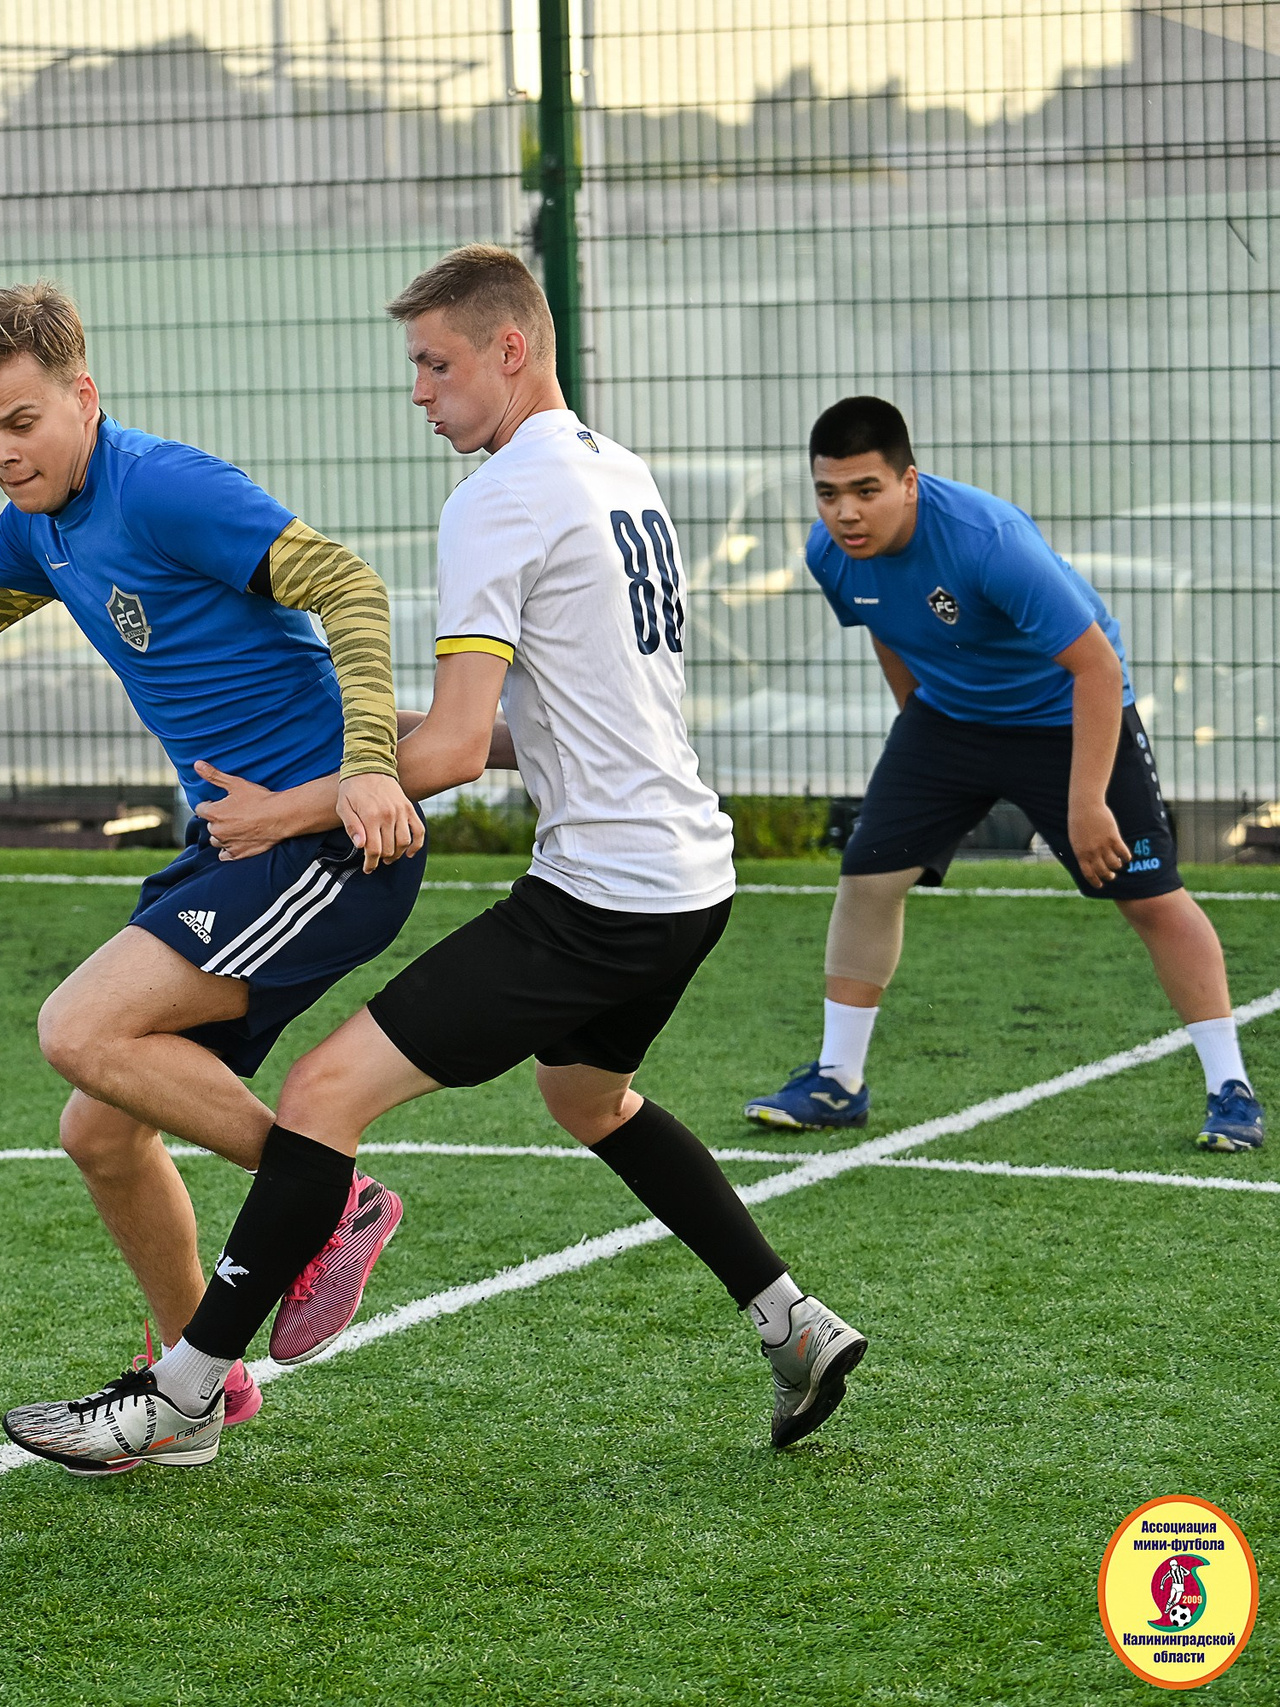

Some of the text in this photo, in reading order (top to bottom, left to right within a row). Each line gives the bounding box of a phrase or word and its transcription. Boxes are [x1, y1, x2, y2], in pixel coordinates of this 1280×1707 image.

[610, 509, 684, 655] 80
[935, 601, 954, 613] FC
[116, 609, 142, 632] FC
[1134, 838, 1151, 856] 46
[1127, 857, 1161, 873] JAKO
[177, 911, 212, 945] adidas
[200, 1364, 224, 1399] SPORT
